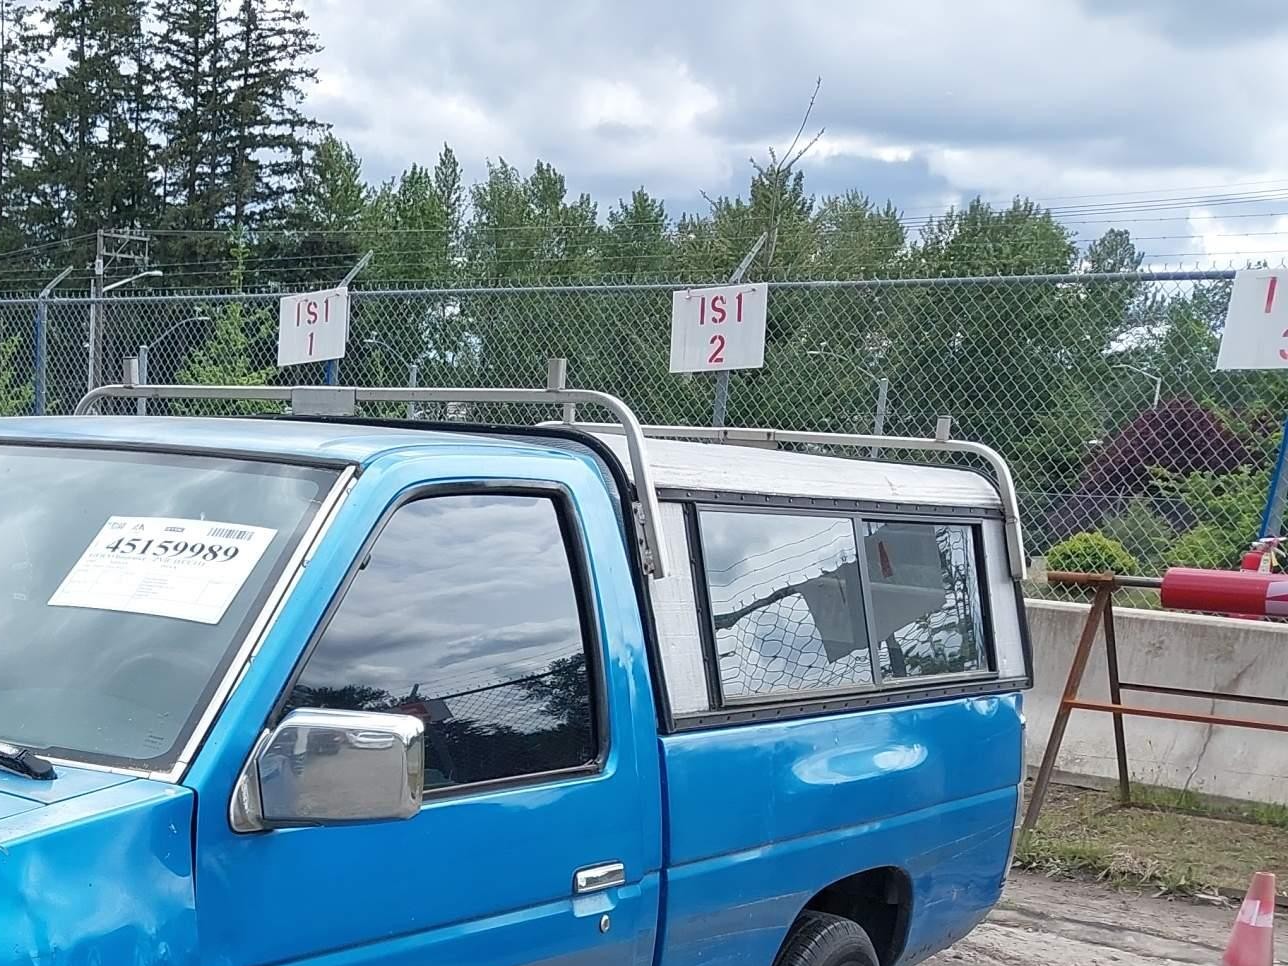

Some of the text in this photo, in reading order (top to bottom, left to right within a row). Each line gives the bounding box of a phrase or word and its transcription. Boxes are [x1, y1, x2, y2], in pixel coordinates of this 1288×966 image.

[308, 331, 314, 356] 1
[708, 334, 726, 363] 2
[106, 537, 240, 563] 45159989
